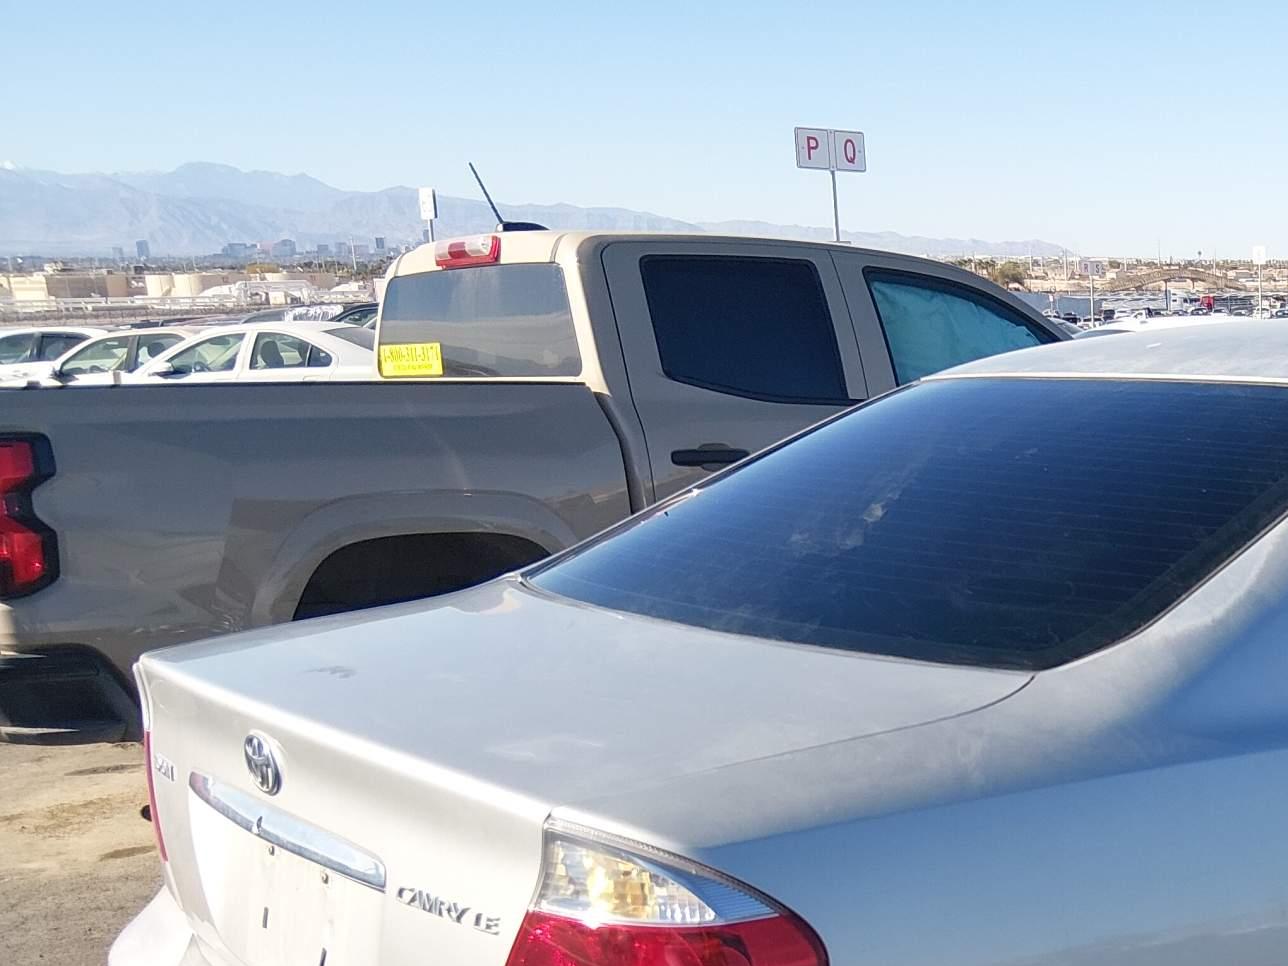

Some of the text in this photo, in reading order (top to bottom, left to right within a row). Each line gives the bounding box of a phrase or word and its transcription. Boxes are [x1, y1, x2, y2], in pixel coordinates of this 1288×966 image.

[806, 135, 819, 161] P
[843, 138, 857, 165] Q
[396, 886, 501, 936] CAMRY LE
